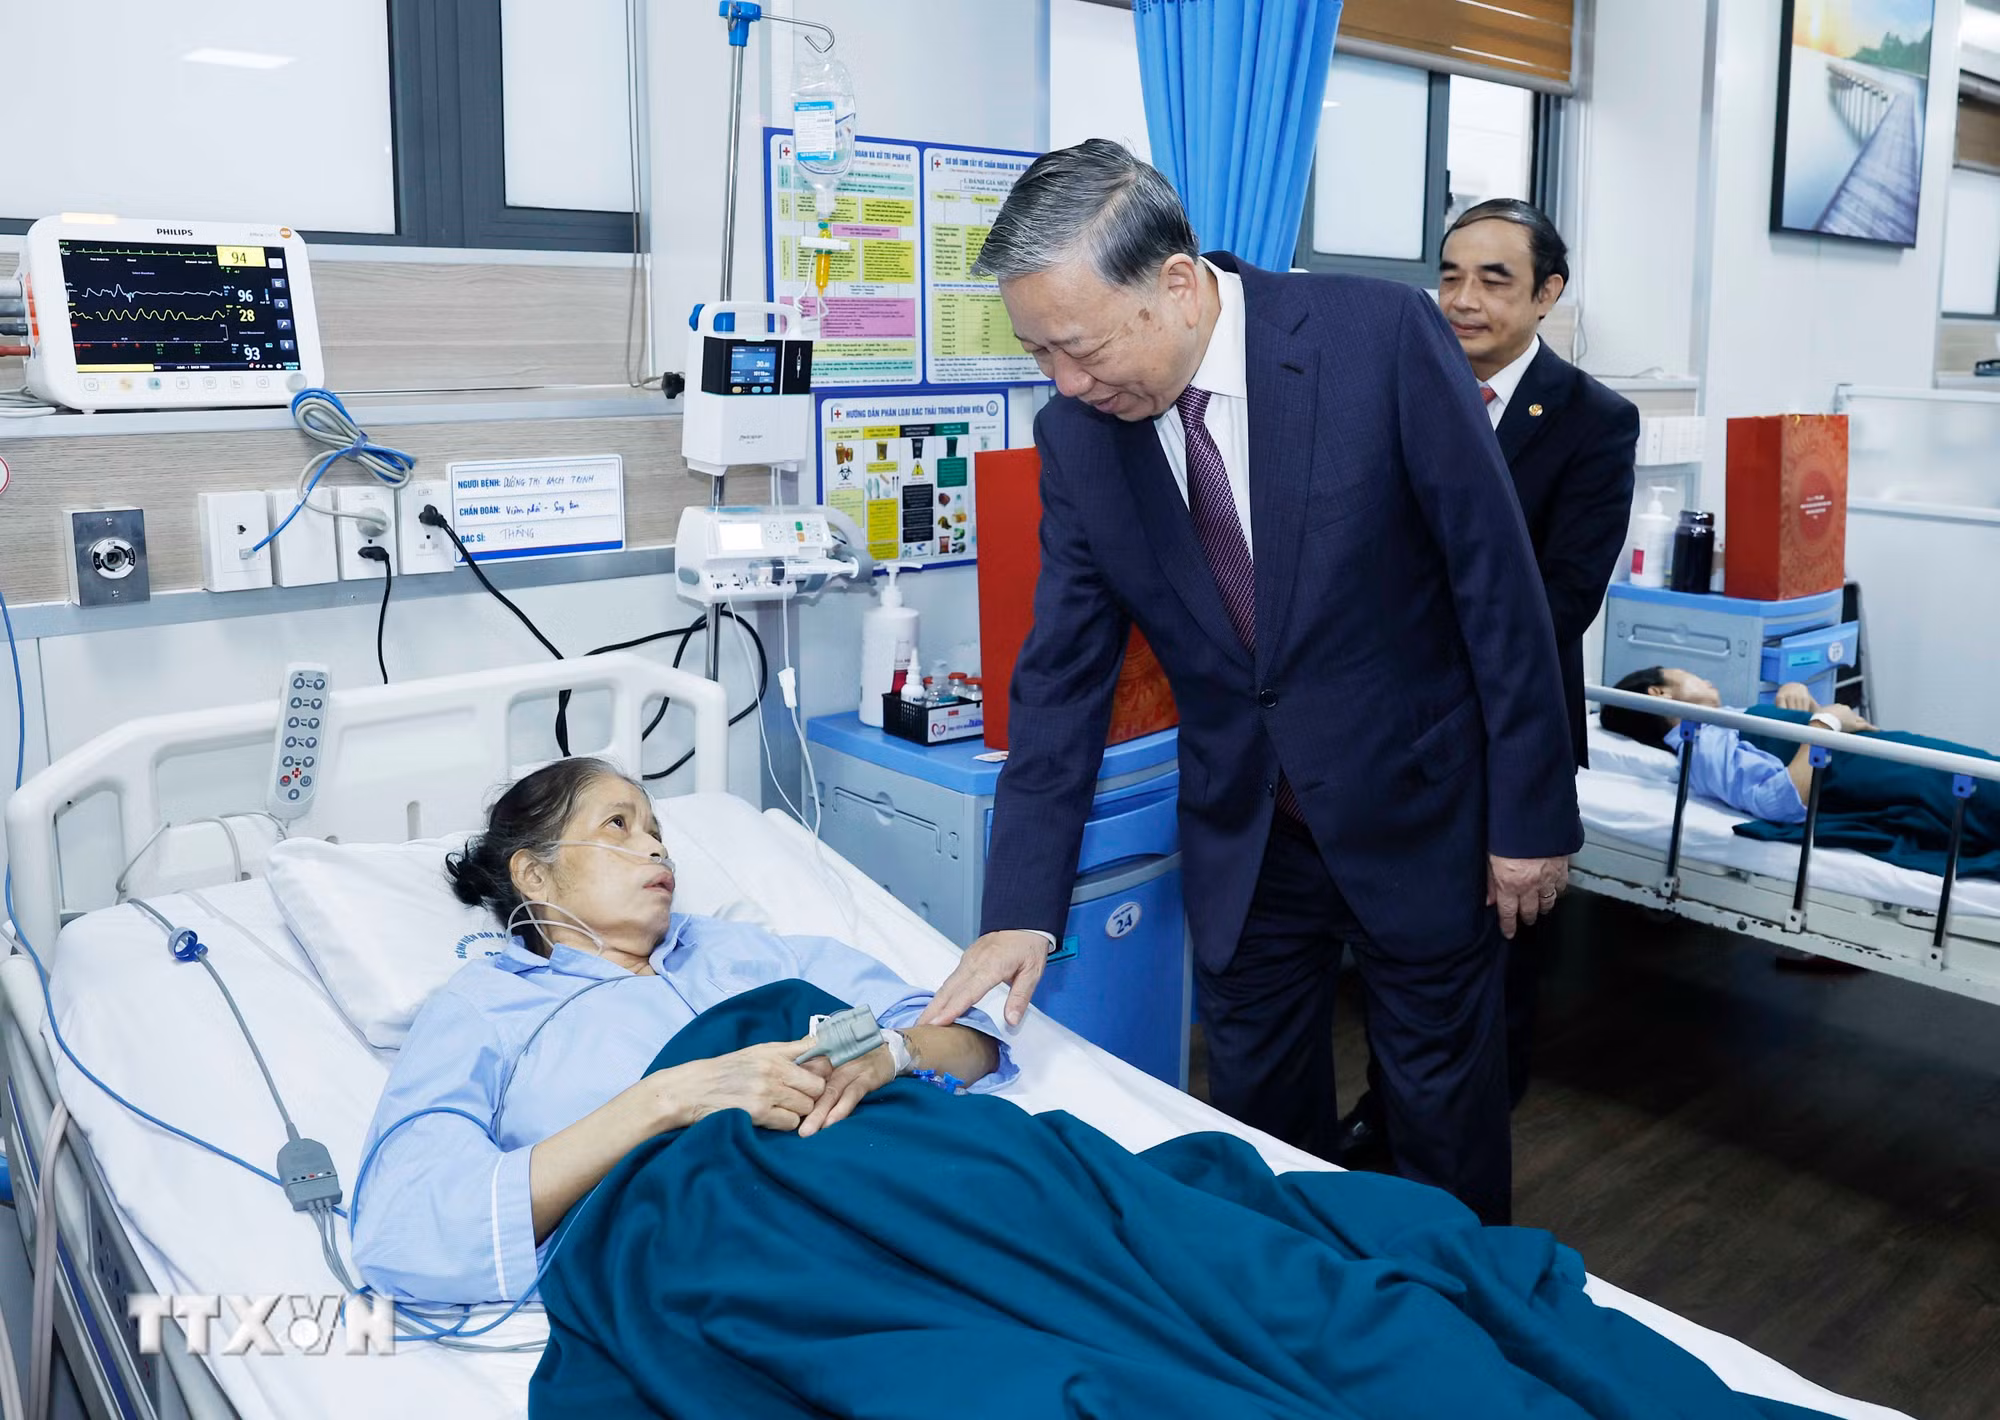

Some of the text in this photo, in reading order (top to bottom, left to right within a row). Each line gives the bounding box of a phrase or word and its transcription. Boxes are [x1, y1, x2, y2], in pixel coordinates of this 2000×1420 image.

[156, 228, 194, 237] PHILIPS
[230, 251, 248, 265] 94
[237, 290, 254, 304] 96
[239, 309, 256, 322] 28
[244, 347, 260, 360] 93
[1116, 912, 1132, 934] 24
